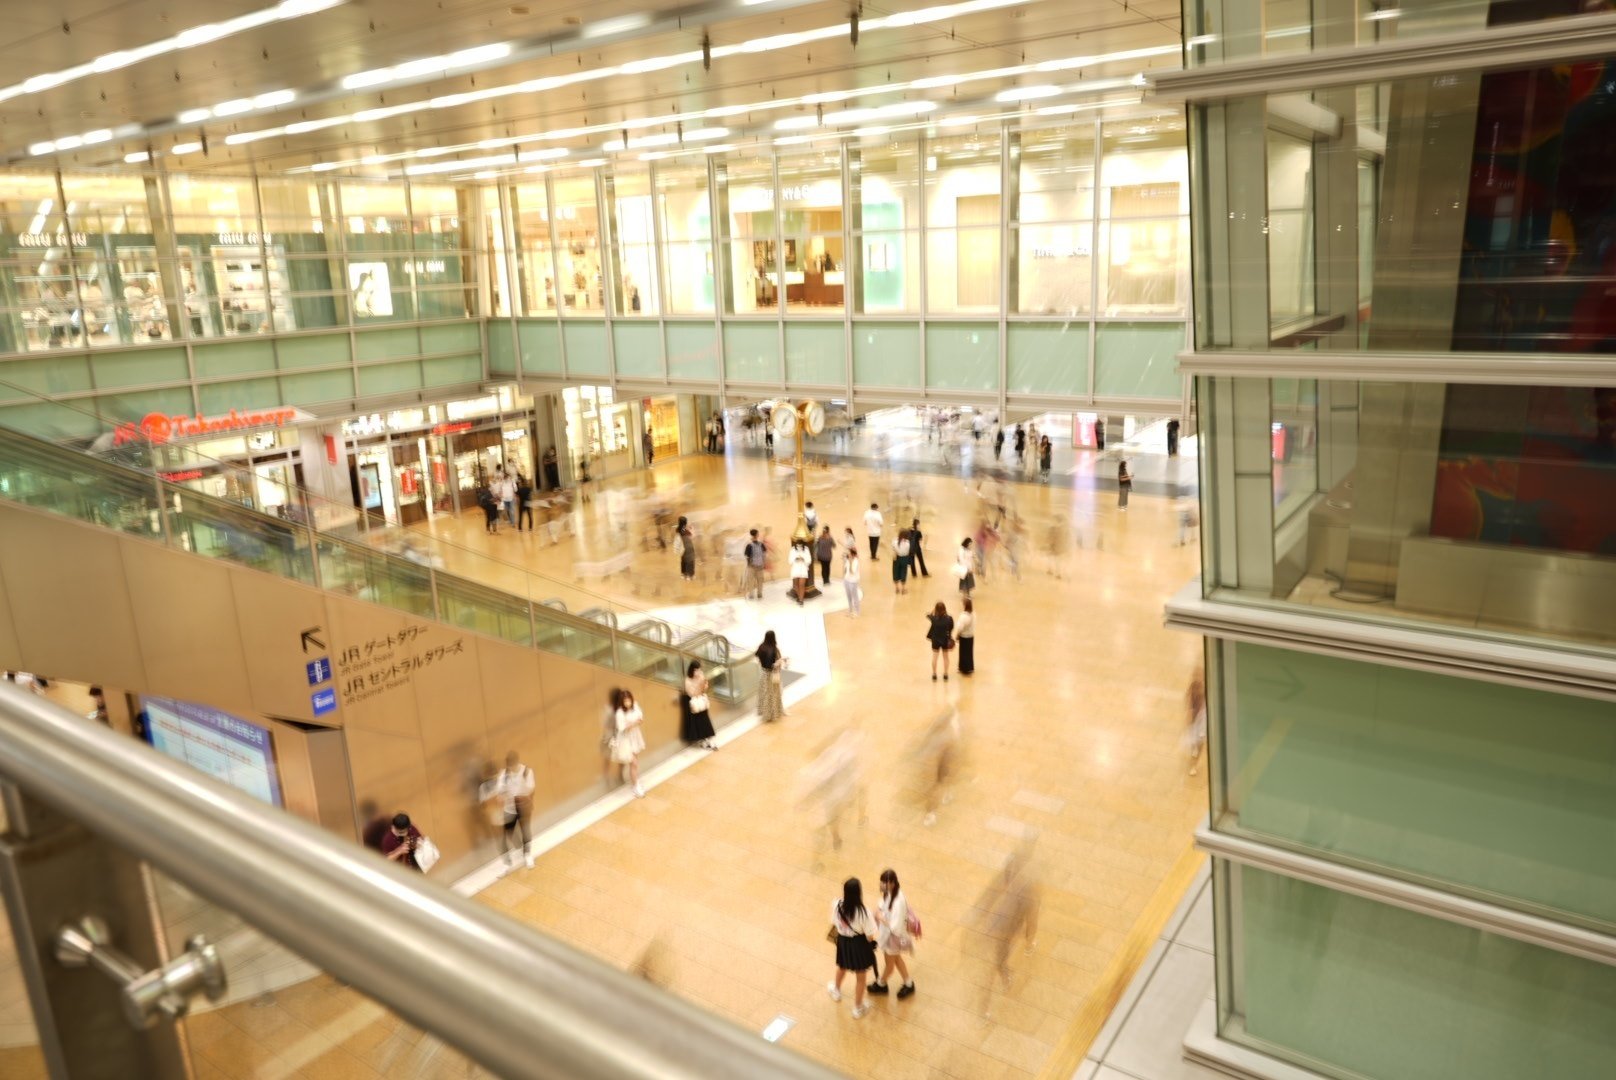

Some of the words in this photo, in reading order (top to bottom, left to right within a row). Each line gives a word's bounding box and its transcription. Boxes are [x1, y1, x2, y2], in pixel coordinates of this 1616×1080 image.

[171, 406, 296, 437] Takashimaya
[338, 645, 361, 668] JR
[364, 625, 429, 656] ゲートタワー
[343, 675, 365, 698] JR
[368, 638, 465, 685] セントラルタワーズ
